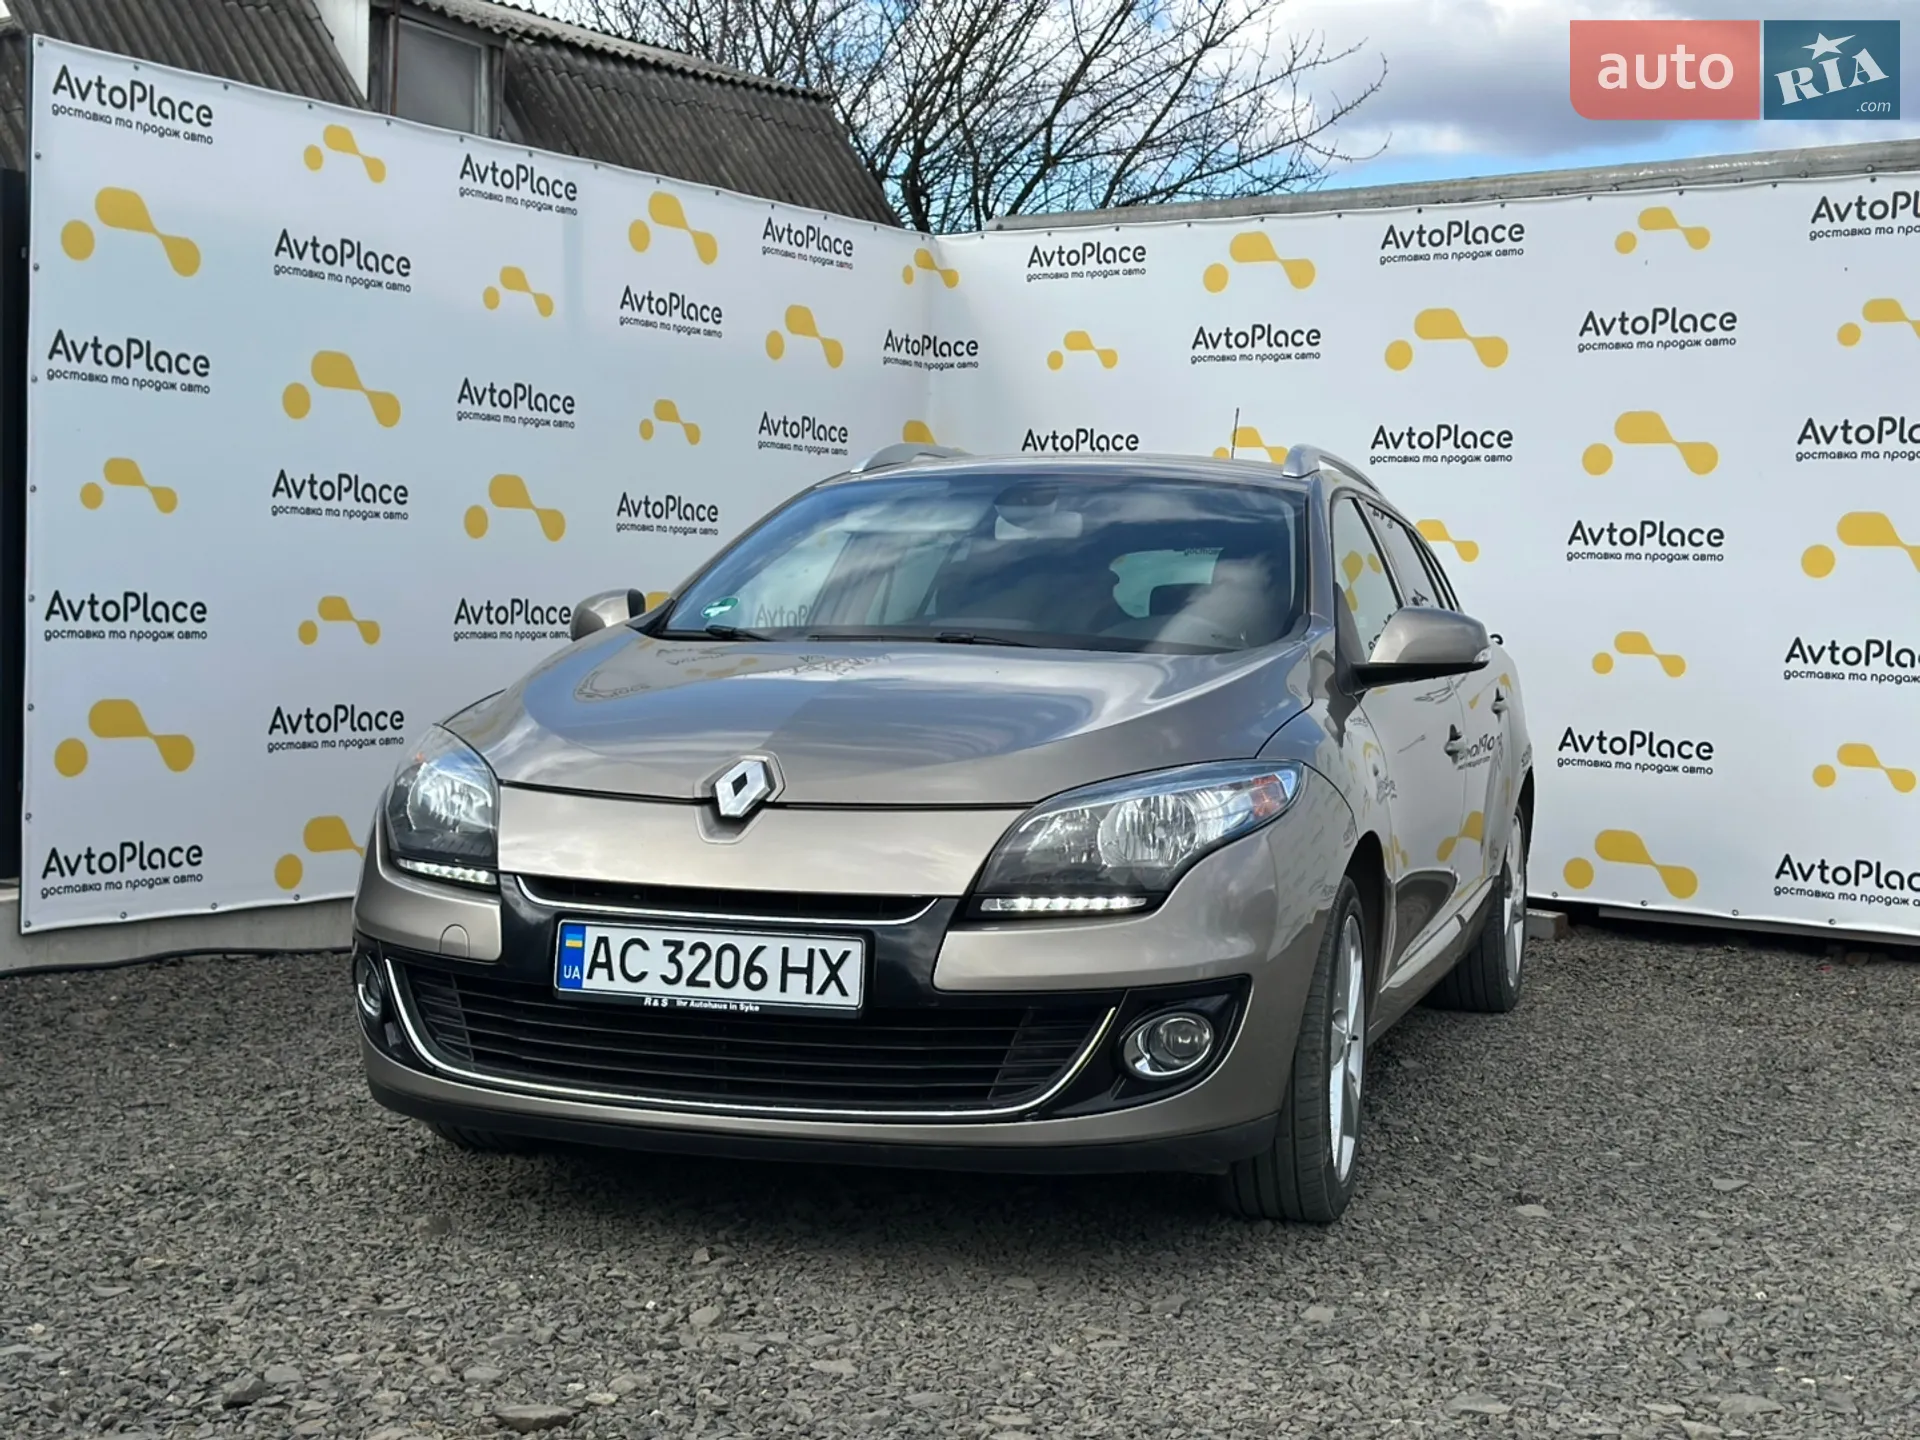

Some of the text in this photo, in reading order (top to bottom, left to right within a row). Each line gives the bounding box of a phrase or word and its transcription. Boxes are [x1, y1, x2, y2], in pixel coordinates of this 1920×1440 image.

[53, 65, 213, 127] AvtoPlace
[52, 104, 213, 145] доставка та продаж авто
[460, 153, 577, 201] AvtoPlace
[459, 187, 577, 216] доставка та продаж авто
[763, 216, 853, 257] AvtoPlace
[1381, 222, 1525, 250] AvtoPlace
[1809, 227, 1872, 241] доставка
[1875, 226, 1894, 235] та
[274, 229, 411, 277] AvtoPlace
[1027, 241, 1146, 268] AvtoPlace
[1380, 253, 1431, 265] доставка
[1451, 250, 1493, 261] продаж
[1495, 248, 1524, 257] авто
[274, 265, 411, 293] доставка та продаж авто
[1026, 272, 1069, 282] доставка
[1086, 269, 1120, 279] продаж
[620, 285, 722, 325] AvtoPlace
[1579, 307, 1737, 337] AvtoPlace
[883, 329, 978, 358] AvtoPlace
[1192, 324, 1321, 350] AvtoPlace
[1578, 338, 1736, 353] доставка та продаж авто
[48, 329, 210, 378] AvtoPlace
[47, 369, 210, 394] доставка та продаж авто
[457, 377, 575, 415] AvtoPlace
[457, 411, 575, 429] доставка та продаж авто
[759, 411, 848, 444] AvtoPlace
[1022, 428, 1139, 452] AvtoPlace
[1371, 424, 1513, 450] AvtoPlace
[1370, 455, 1420, 465] доставка
[1422, 455, 1438, 463] та
[1440, 455, 1482, 465] продаж
[1795, 451, 1858, 462] доставка
[1861, 451, 1880, 459] та
[272, 469, 408, 505] AvtoPlace
[271, 505, 408, 521] доставка та продаж авто
[617, 492, 718, 523] AvtoPlace
[1568, 520, 1725, 548] AvtoPlace
[1567, 552, 1724, 563] доставка та продаж авто
[45, 590, 207, 624] AvtoPlace
[454, 598, 571, 625] AvtoPlace
[44, 630, 207, 642] доставка та продаж авто
[453, 632, 498, 641] доставка
[500, 631, 512, 639] та
[515, 631, 547, 641] продаж
[1783, 670, 1845, 680] доставка
[1848, 672, 1868, 681] та
[268, 704, 404, 735] AvtoPlace
[267, 737, 404, 753] доставка та продаж авто
[1558, 727, 1714, 761] AvtoPlace
[1557, 755, 1713, 775] доставка та продаж авто
[42, 841, 203, 880] AvtoPlace
[41, 874, 203, 899] доставка та продаж авто
[1774, 886, 1835, 899] доставка
[1838, 892, 1857, 901] та
[1860, 894, 1910, 906] продаж
[564, 965, 580, 979] UA
[587, 936, 851, 996] AC 3206 HX
[690, 1001, 727, 1009] Autohaus
